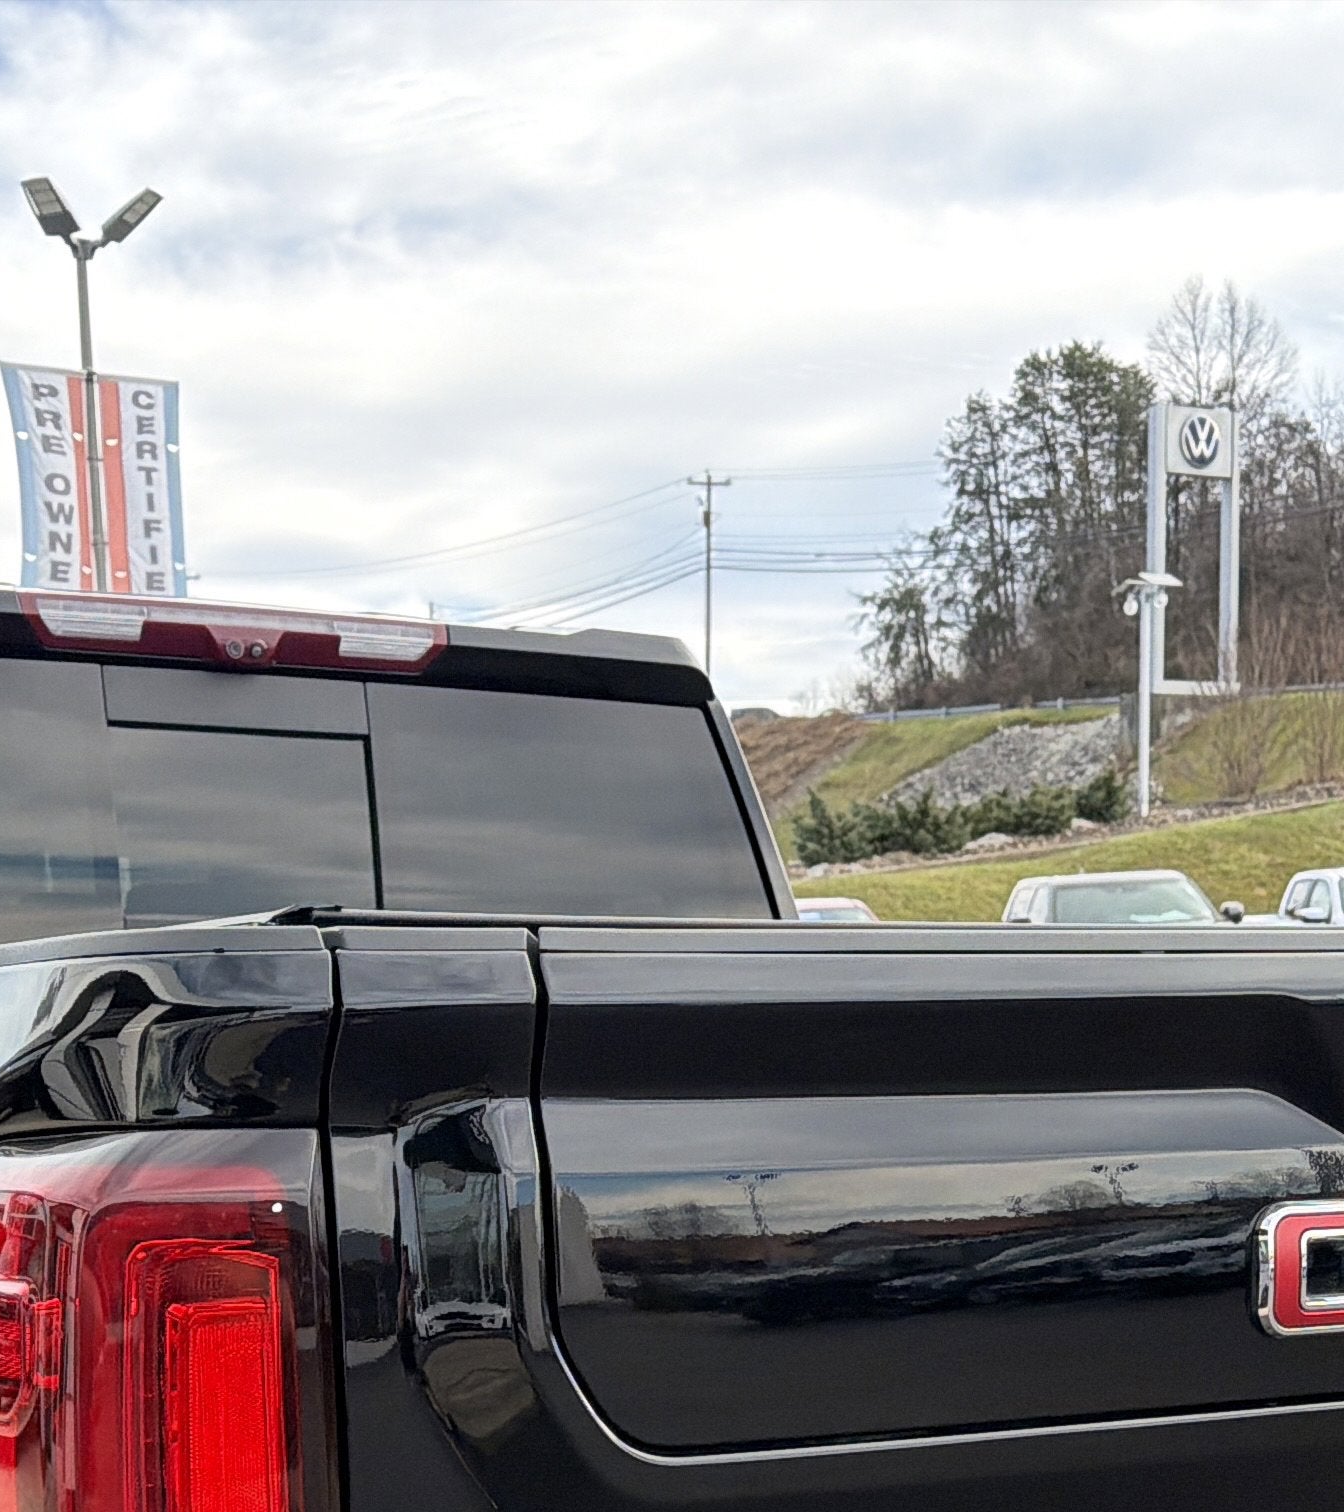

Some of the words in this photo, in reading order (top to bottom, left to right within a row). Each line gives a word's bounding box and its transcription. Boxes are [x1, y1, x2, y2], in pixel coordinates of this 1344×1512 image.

[31, 382, 67, 457] PRE
[43, 471, 75, 584] OWNE
[131, 389, 166, 593] CERTIFIE
